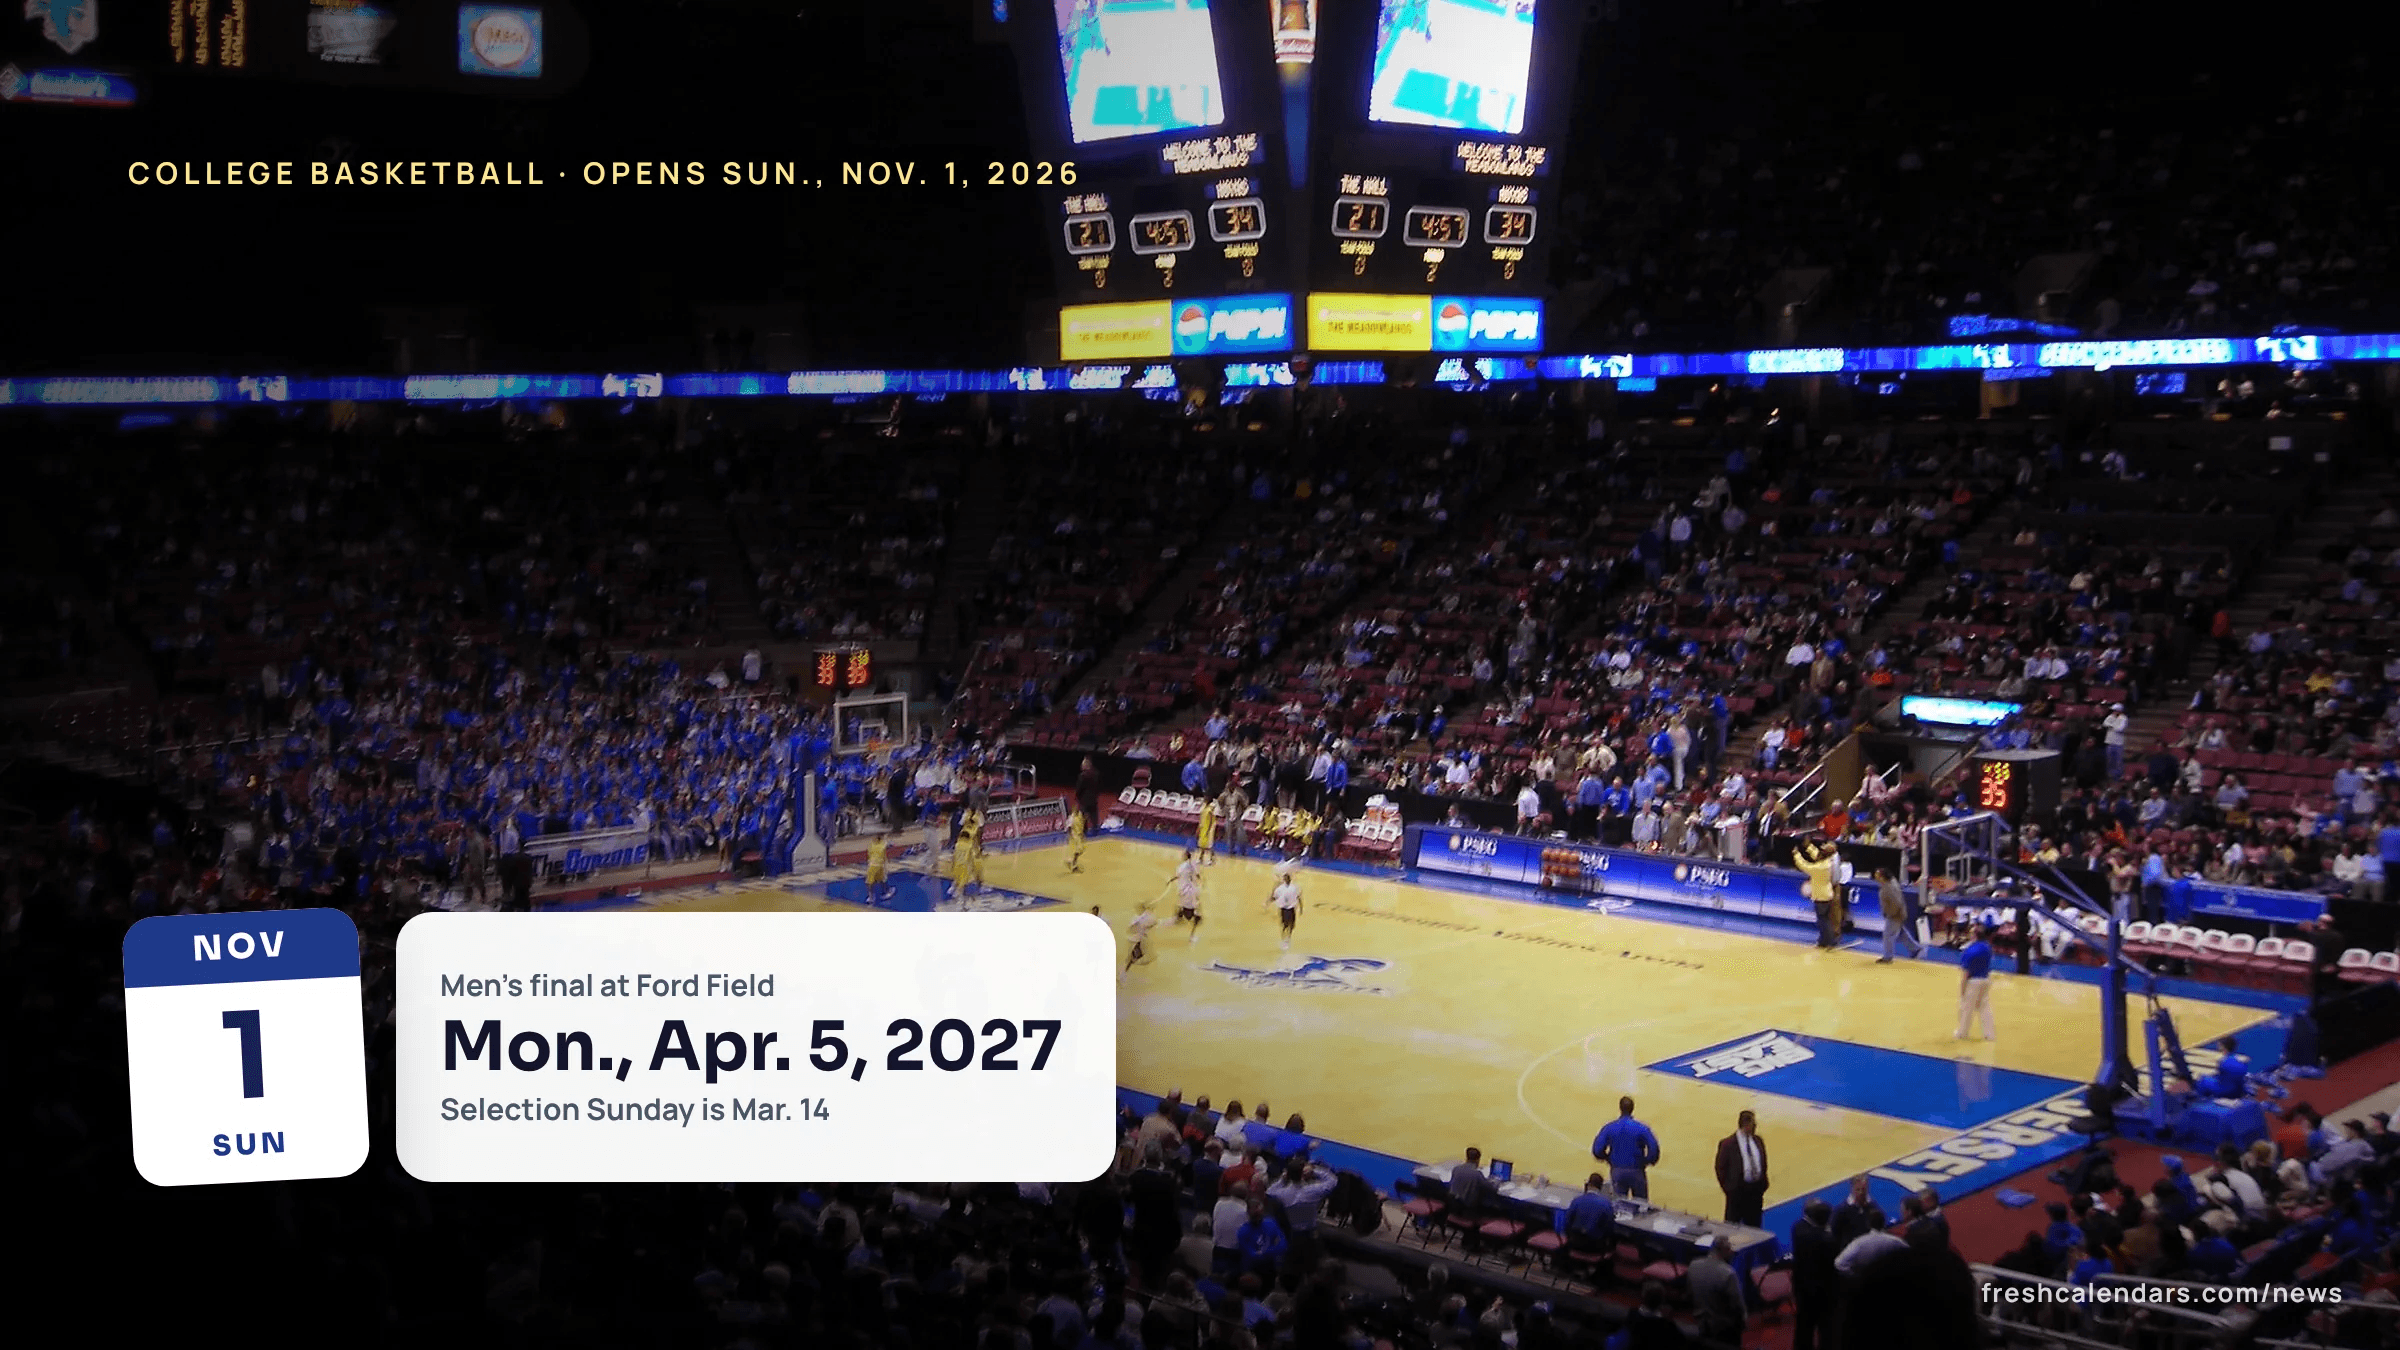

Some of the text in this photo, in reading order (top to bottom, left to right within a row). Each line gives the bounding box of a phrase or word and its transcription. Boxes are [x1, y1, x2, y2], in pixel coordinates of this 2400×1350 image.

[1225, 206, 1255, 235] 34
[1349, 203, 1378, 232] 21
[1500, 211, 1527, 239] 34
[1981, 777, 2007, 808] 35
[1869, 1098, 2093, 1193] JERSEY
